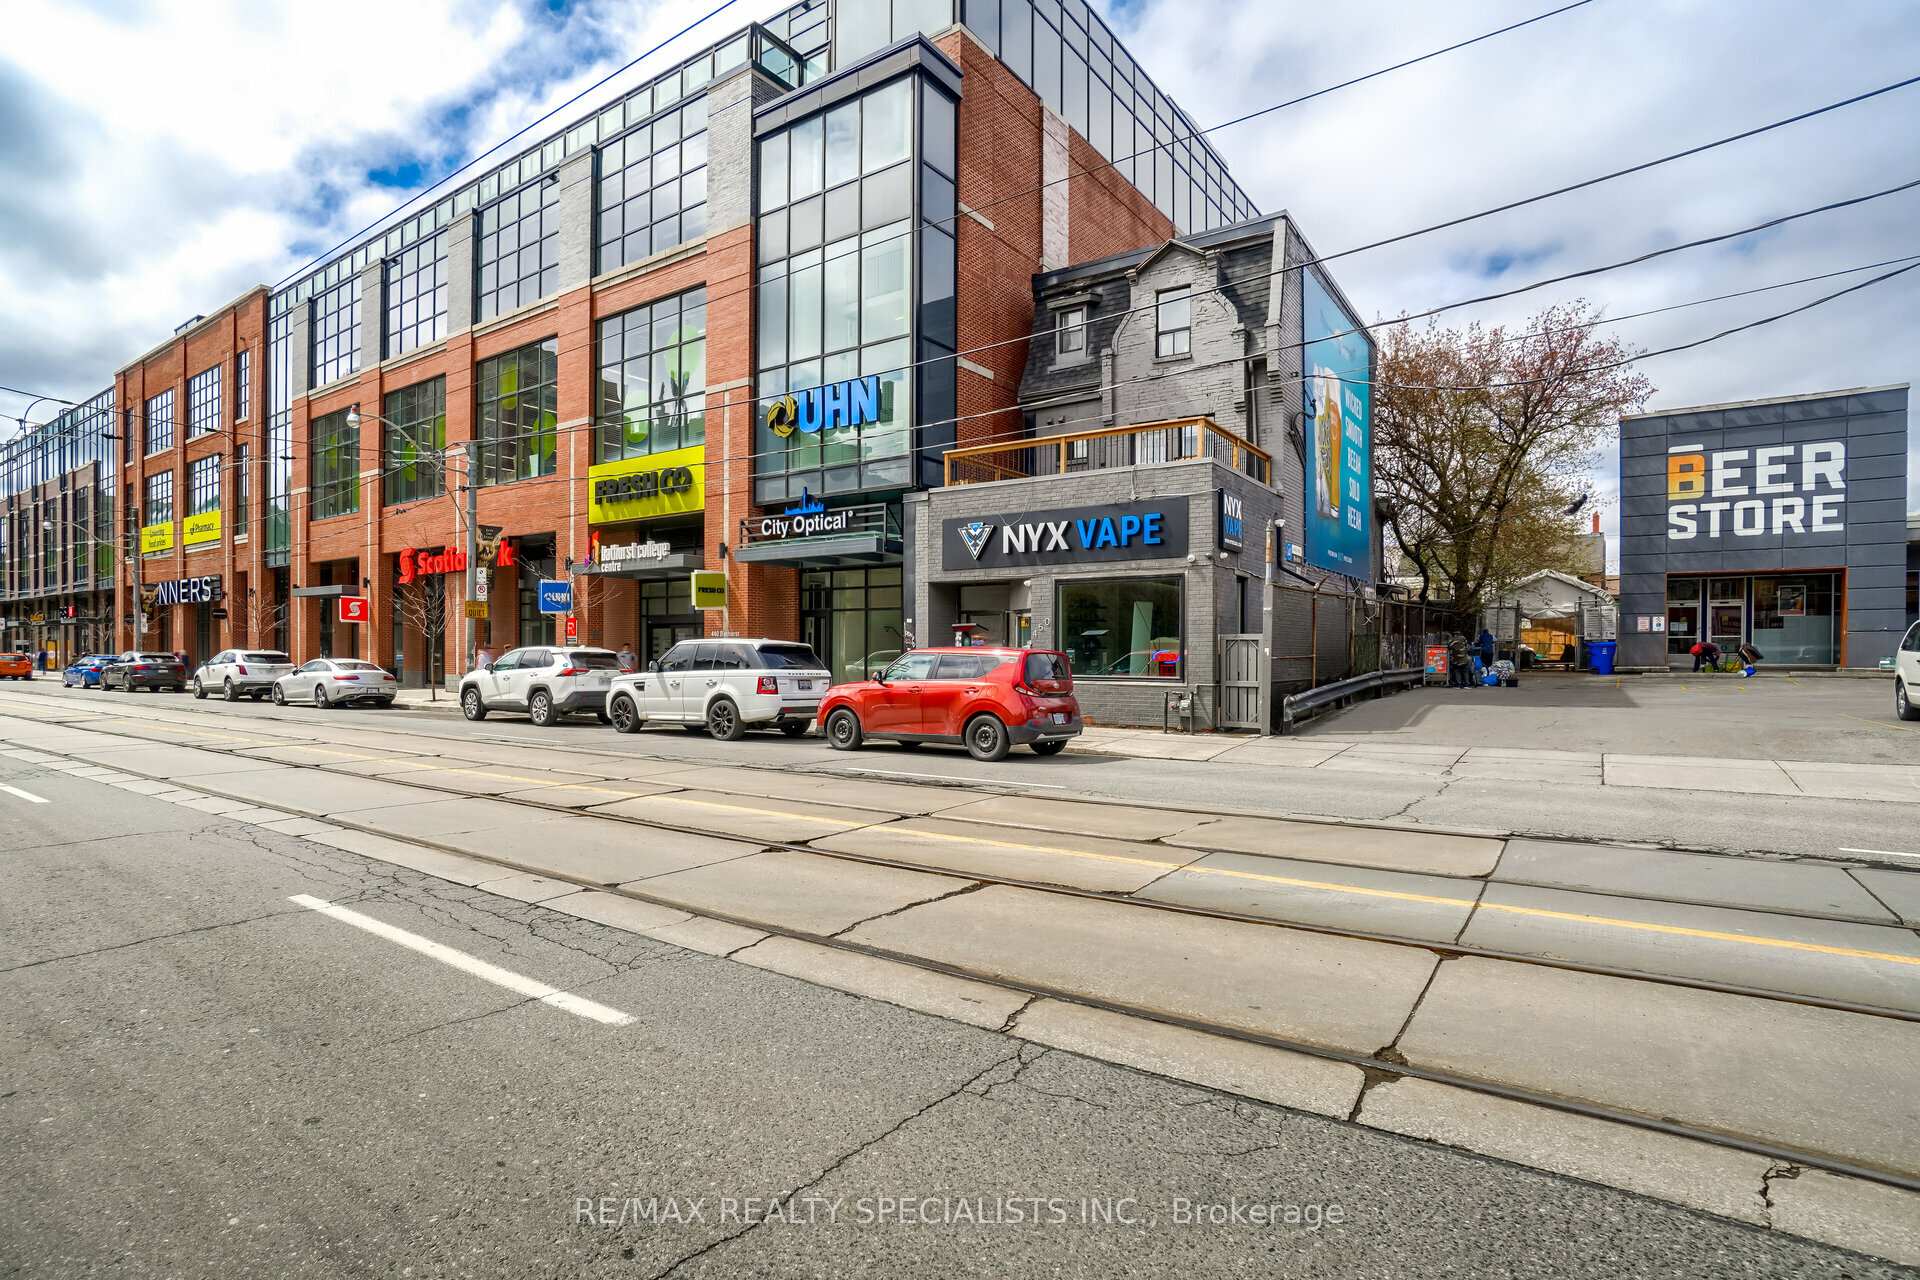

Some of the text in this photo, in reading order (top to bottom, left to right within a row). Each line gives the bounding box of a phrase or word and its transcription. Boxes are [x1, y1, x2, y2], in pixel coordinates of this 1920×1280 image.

[798, 375, 880, 433] UHN
[1667, 441, 1846, 500] BEER
[1225, 494, 1242, 520] NYX
[1668, 494, 1845, 540] STORE
[761, 511, 846, 538] City Optical
[1002, 512, 1162, 554] NYX VAPE
[1225, 515, 1243, 538] VAPE
[417, 540, 513, 575] Scotiak
[601, 562, 621, 572] centre
[157, 576, 211, 604] NNERS
